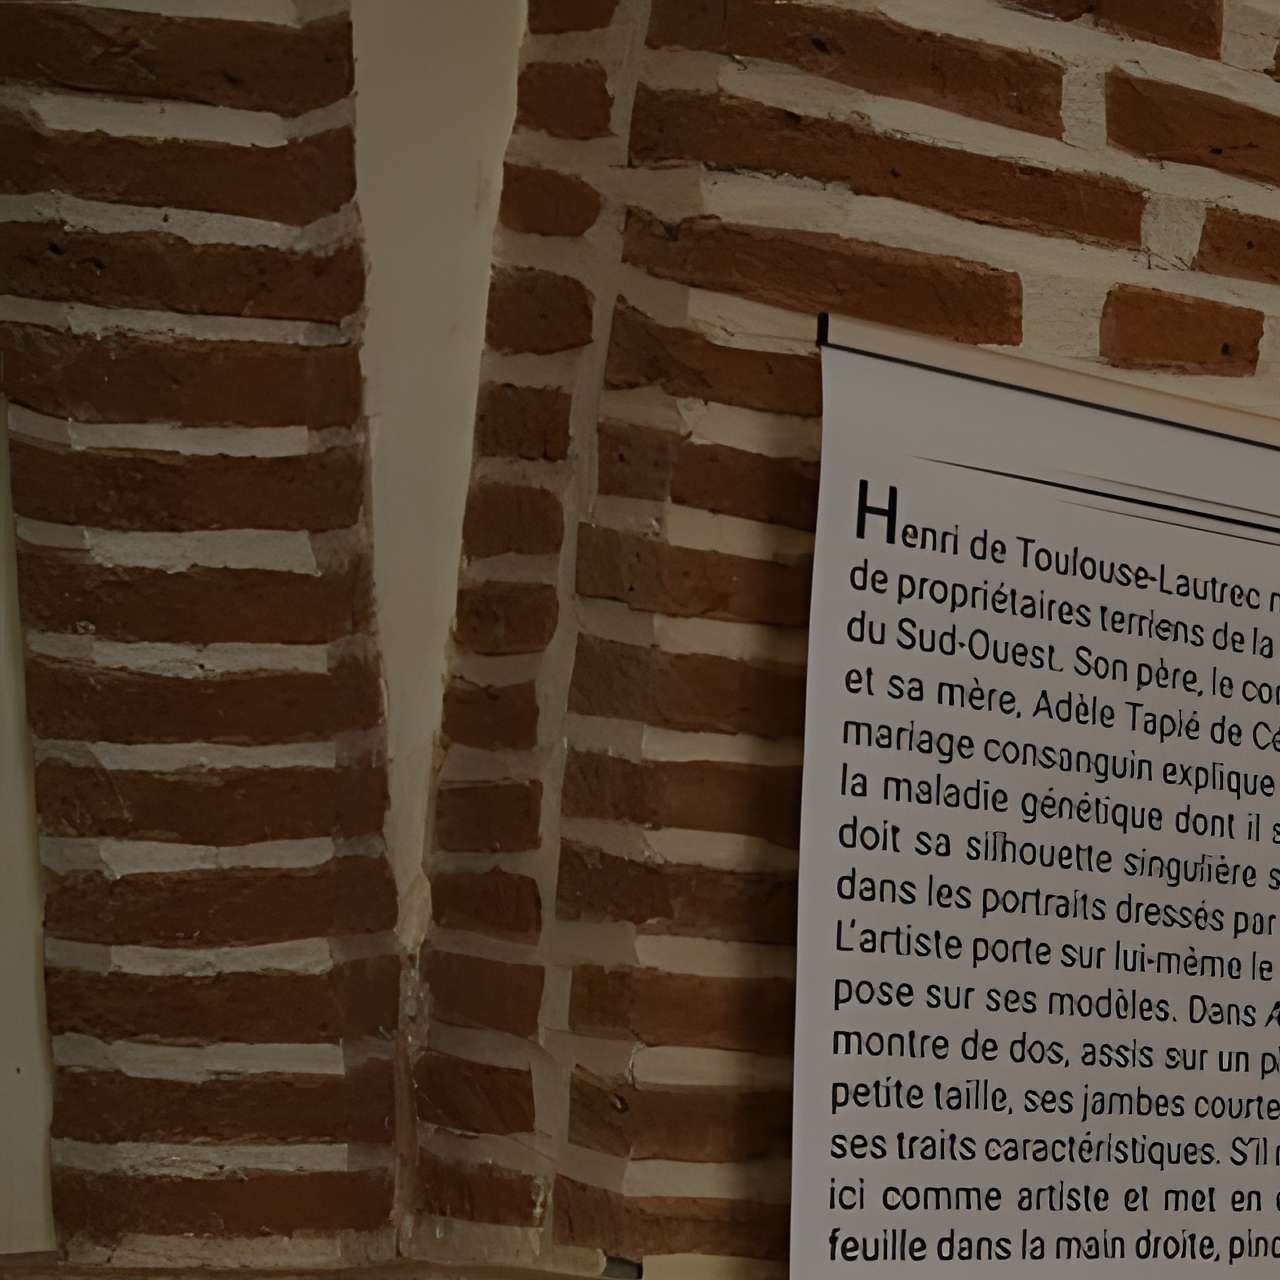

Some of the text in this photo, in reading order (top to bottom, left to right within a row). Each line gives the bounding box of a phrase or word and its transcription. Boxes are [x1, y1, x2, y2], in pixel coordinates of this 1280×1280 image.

[856, 478, 959, 556] Henri
[969, 528, 1007, 564] de
[1015, 536, 1261, 610] Toulouse-Lautrec
[849, 558, 889, 595] de
[897, 573, 1092, 628] propriétaires
[1212, 621, 1245, 654] de
[1252, 626, 1274, 659] la
[846, 609, 886, 645] du
[1073, 645, 1128, 682] Son
[1212, 666, 1234, 699] le
[844, 667, 875, 696] et
[887, 674, 924, 702] sa
[1210, 714, 1243, 747] de
[840, 762, 868, 797] la
[883, 773, 1009, 813] maladie
[1175, 803, 1235, 840] dont
[1247, 812, 1261, 842] il
[838, 815, 901, 853] doit
[914, 831, 951, 857] sa
[836, 867, 917, 905] dans
[928, 873, 972, 910] les
[836, 918, 963, 960] L'artiste
[972, 937, 1052, 969] porte
[1060, 943, 1107, 970] sur
[1251, 951, 1273, 982] le
[834, 978, 914, 1011] pose
[926, 984, 976, 1010] sur
[985, 988, 1037, 1014] ses
[1189, 994, 1257, 1027] Dans
[832, 1029, 950, 1060] montre
[961, 1028, 999, 1062] de
[1080, 1038, 1154, 1069] assis
[1164, 1047, 1209, 1071] sur
[1218, 1050, 1250, 1073] un
[831, 1076, 924, 1115] petite
[1023, 1089, 1074, 1115] ses
[1080, 1083, 1185, 1123] jambes
[830, 1134, 887, 1160] ses
[896, 1128, 977, 1161] traits
[829, 1177, 1262, 1213] ici comme artiste et en
[828, 1227, 927, 1262] feuille
[936, 1228, 1012, 1261] dans
[1021, 1228, 1045, 1260] la
[1055, 1228, 1126, 1260] main
